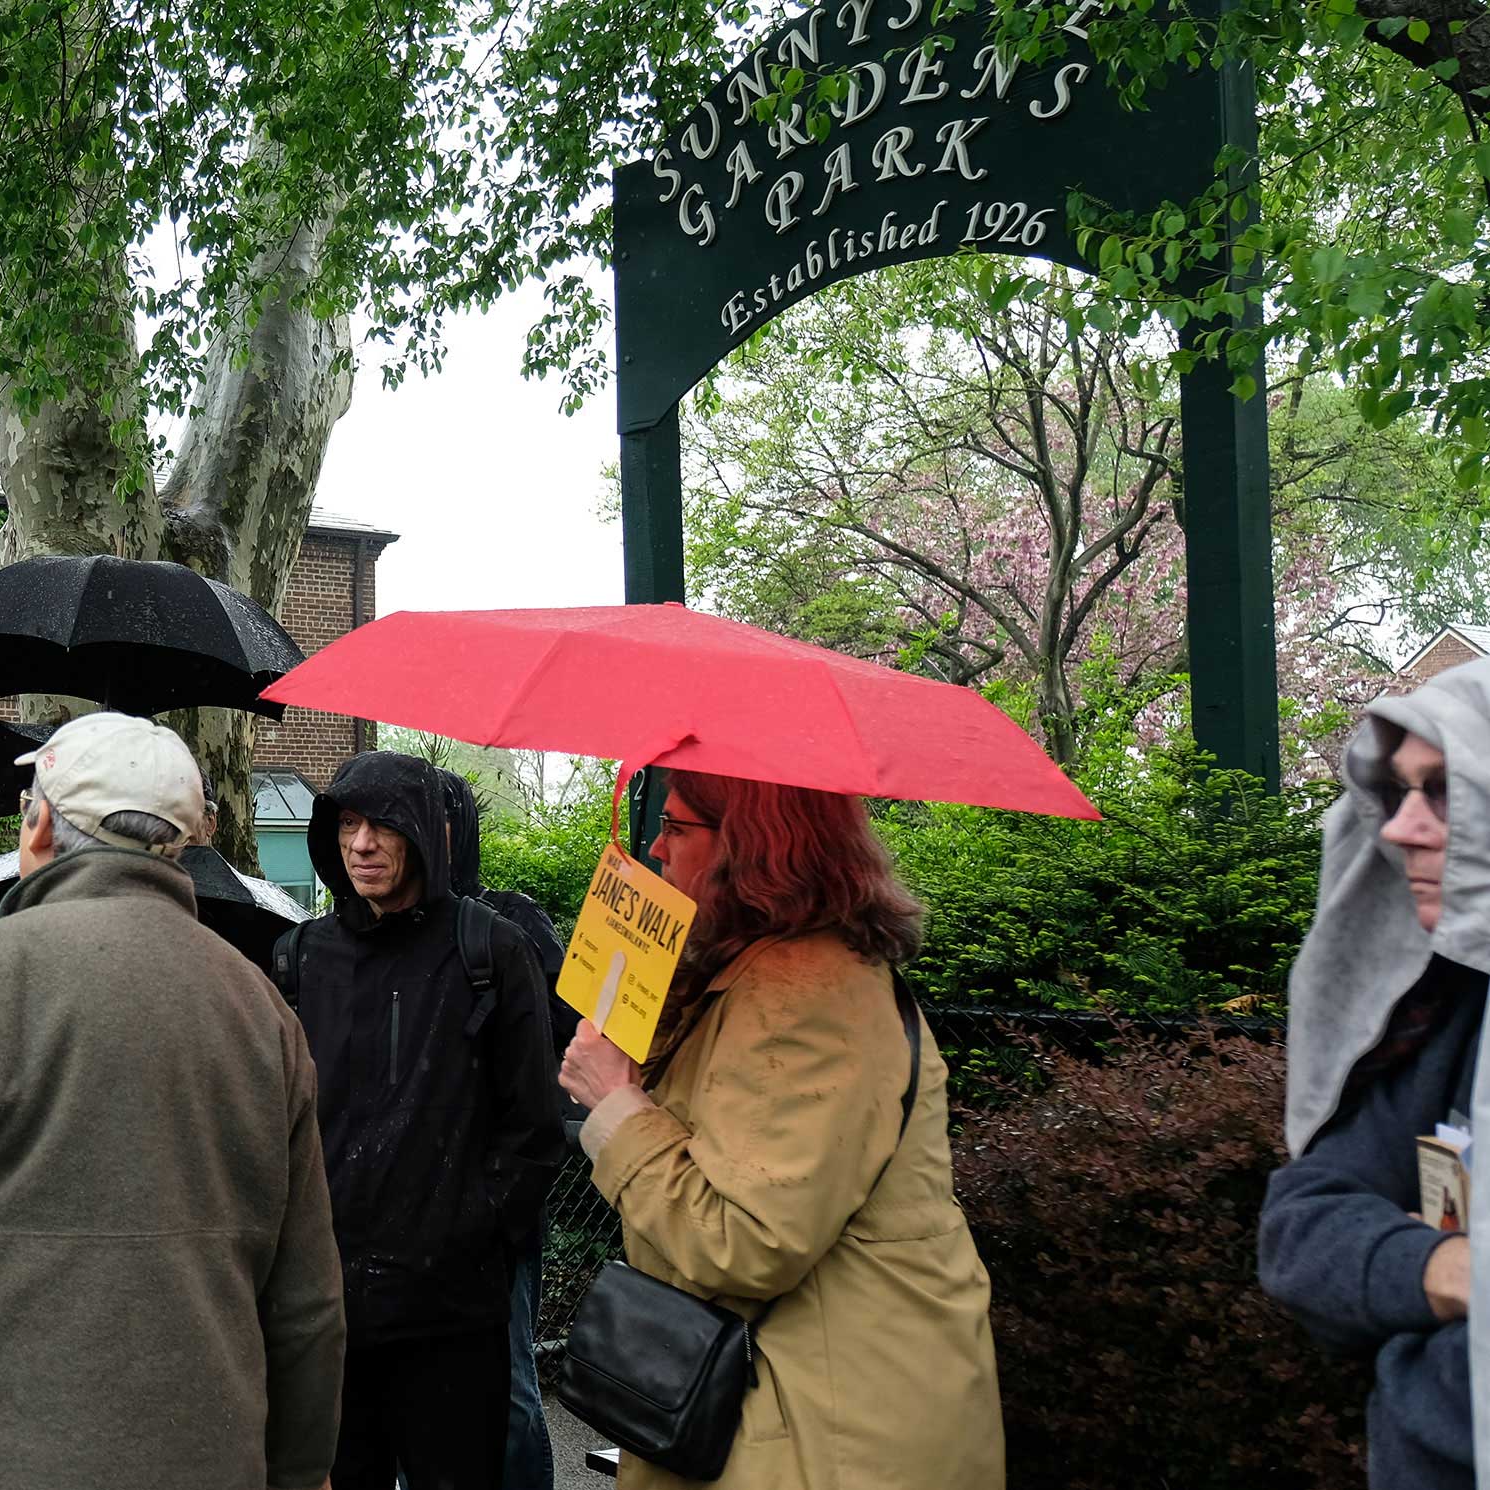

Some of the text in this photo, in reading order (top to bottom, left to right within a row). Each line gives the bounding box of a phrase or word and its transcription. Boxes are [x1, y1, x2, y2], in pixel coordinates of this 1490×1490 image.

[678, 41, 1090, 246] GARDENS
[765, 116, 989, 235] PARK
[721, 199, 1055, 336] Established 1926
[592, 868, 685, 955] JANE'S WALK
